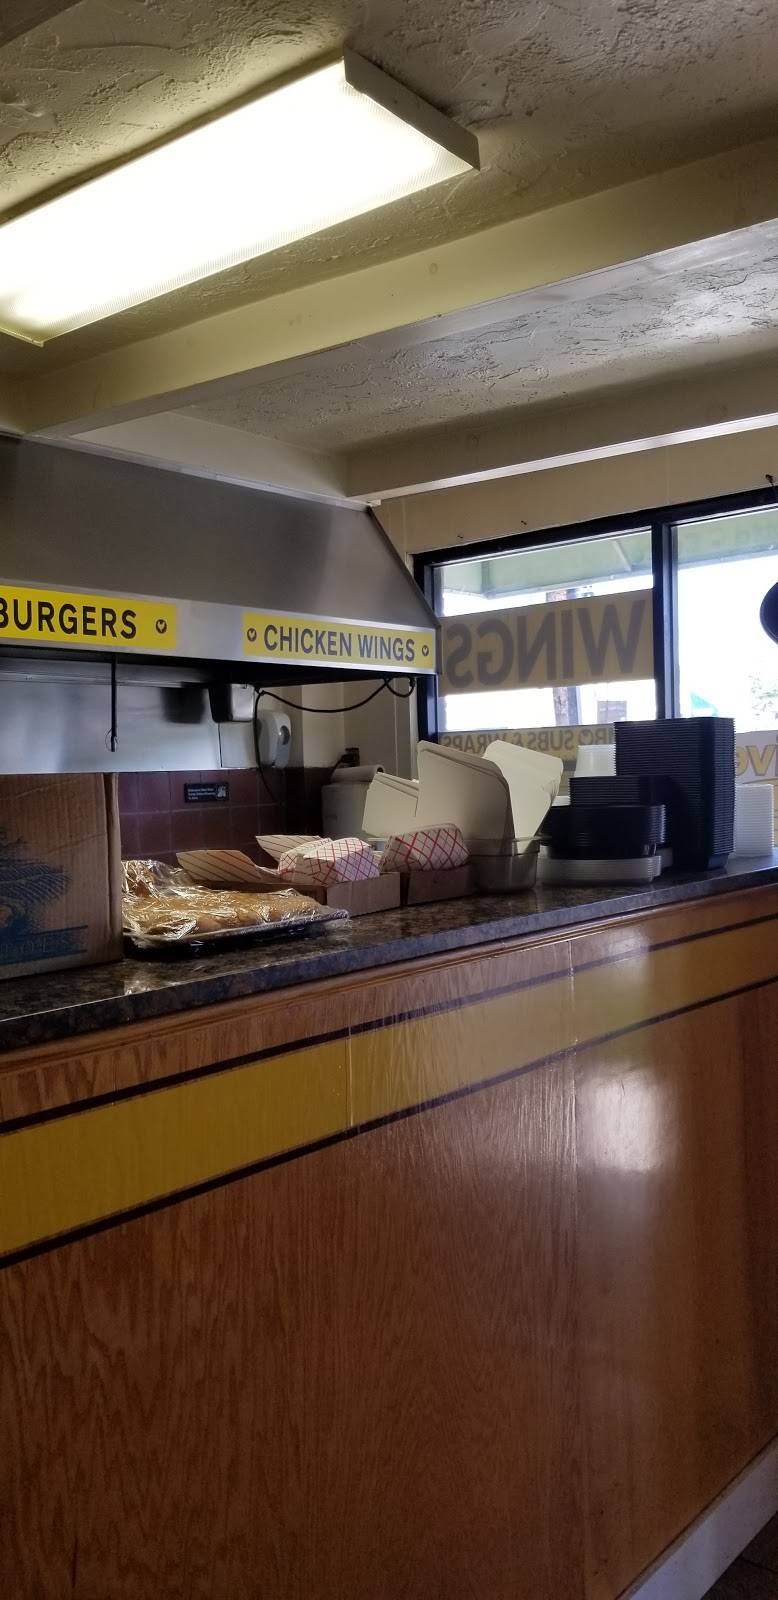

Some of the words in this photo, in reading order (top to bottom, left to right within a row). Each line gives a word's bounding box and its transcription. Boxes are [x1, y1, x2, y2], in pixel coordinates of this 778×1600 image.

[0, 597, 137, 639] BURGERS
[263, 624, 353, 656] CHICKEN
[357, 634, 415, 662] WINGS
